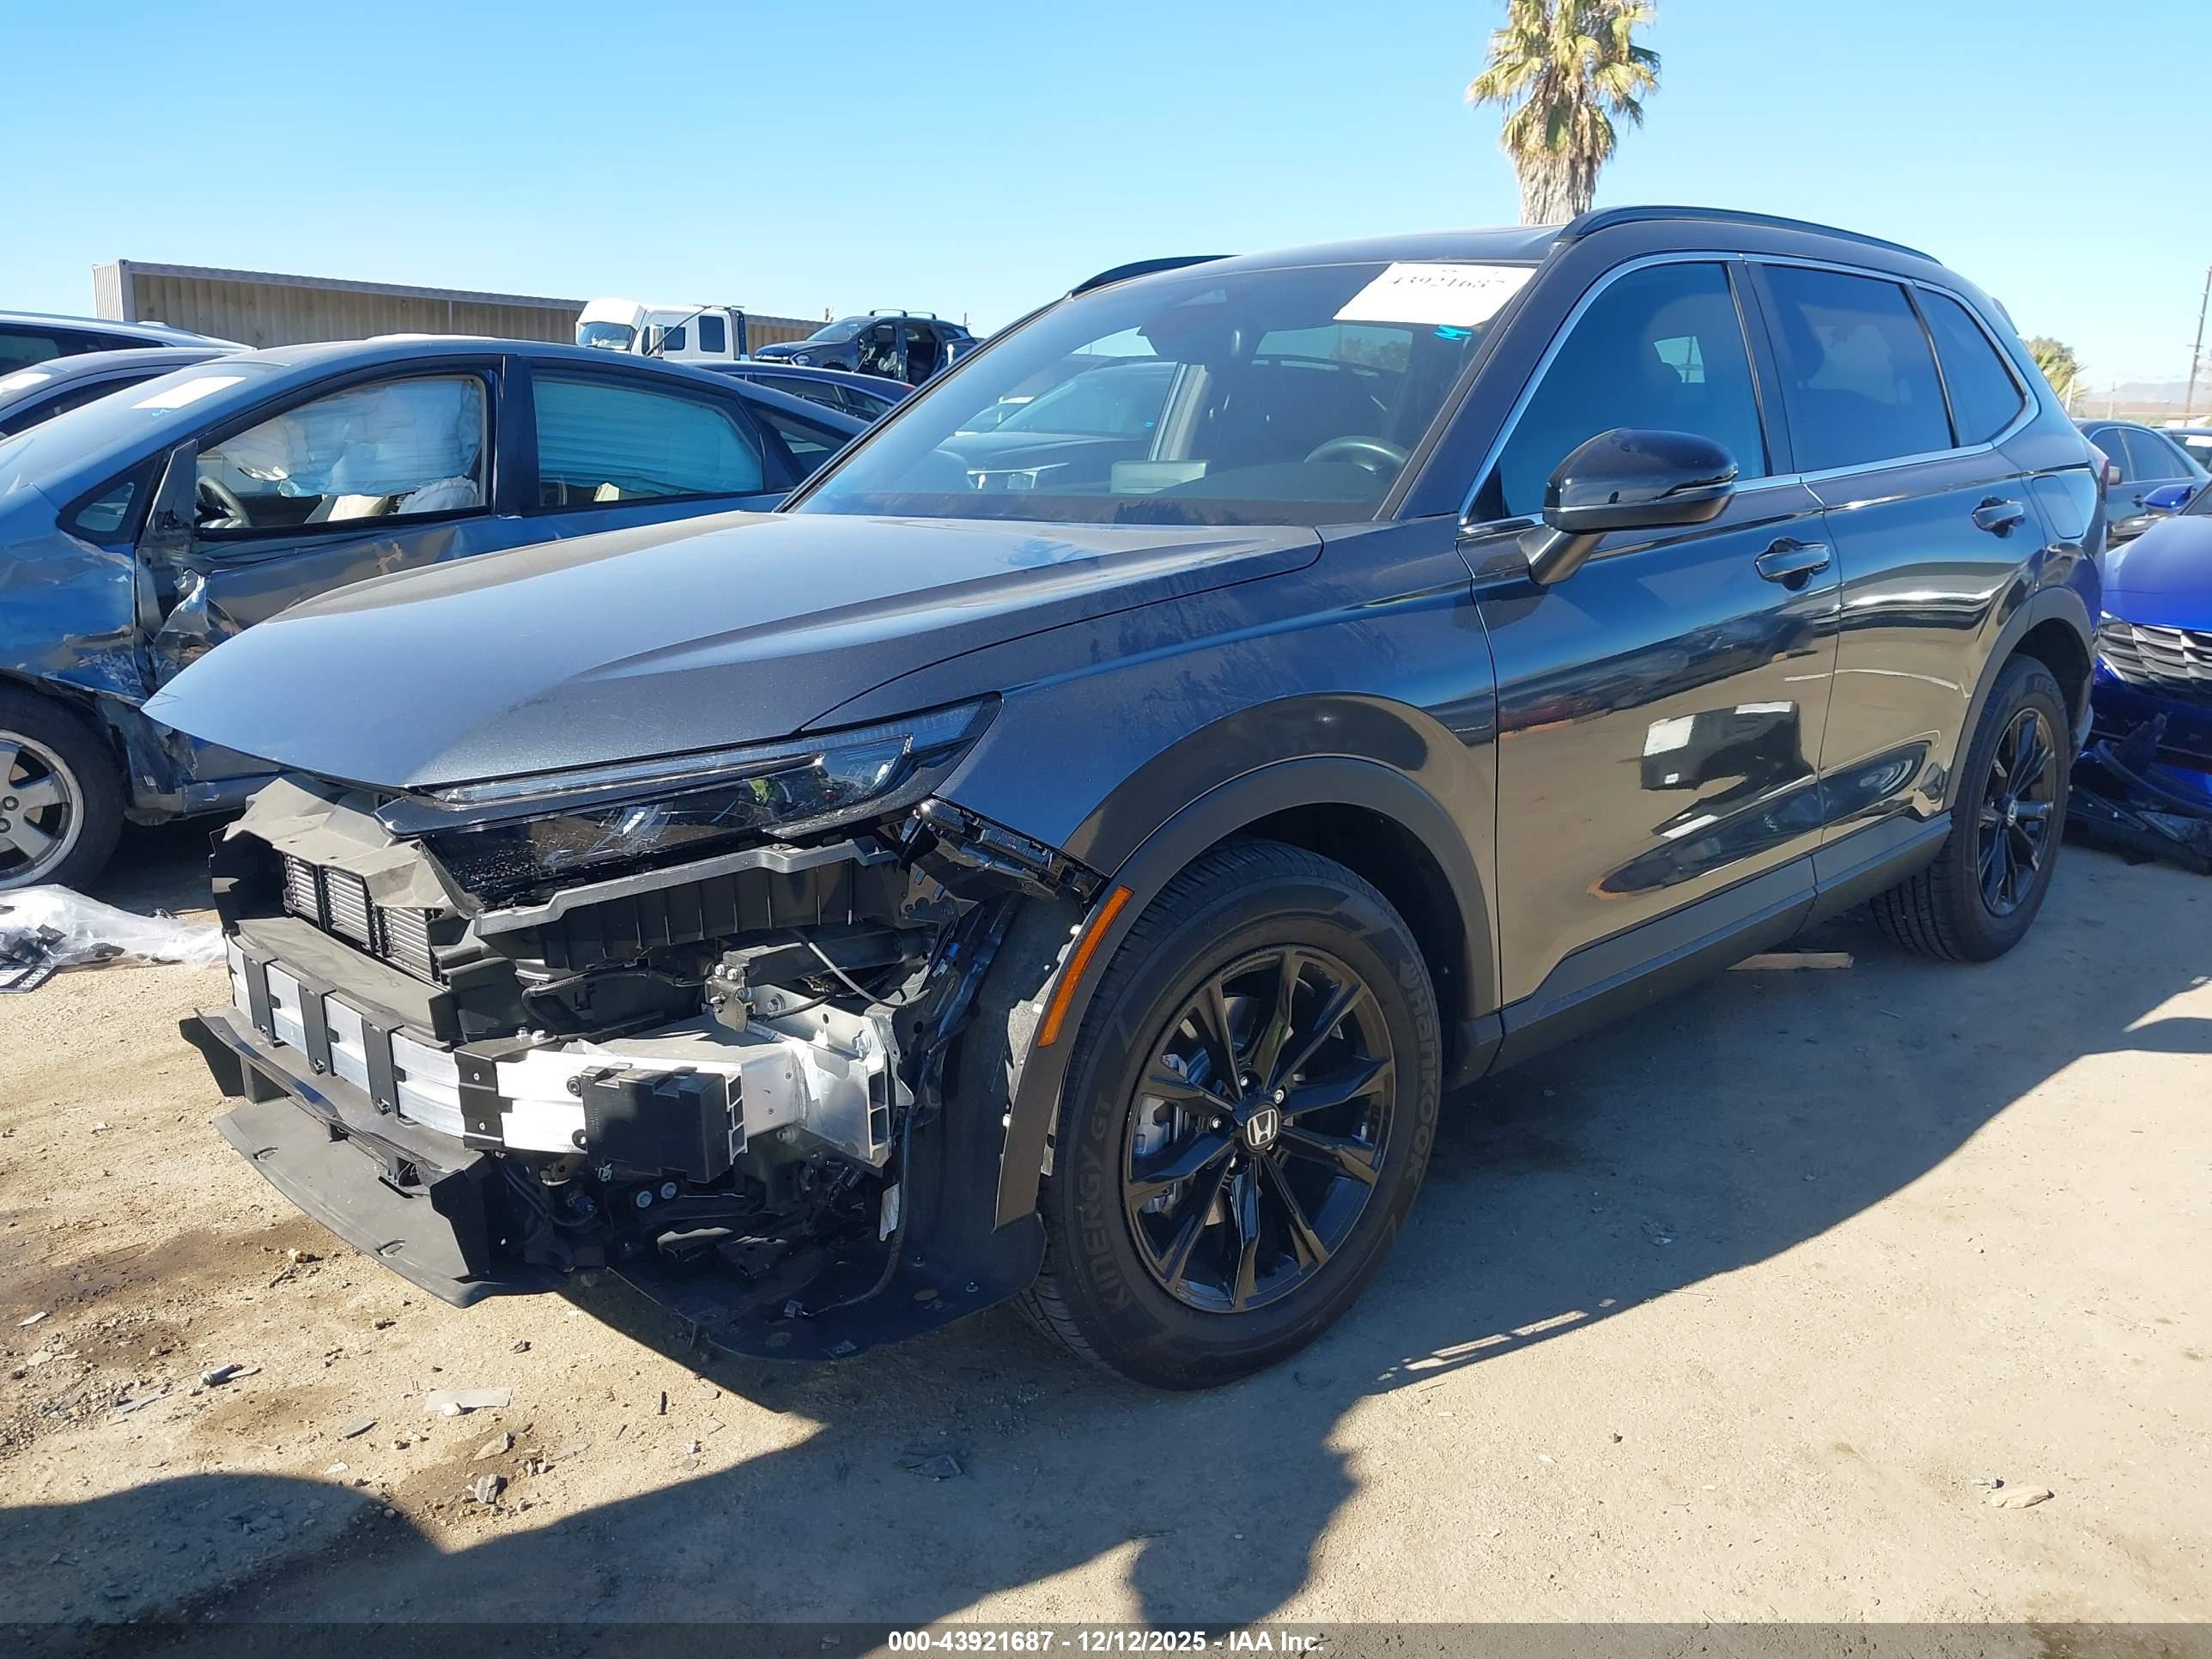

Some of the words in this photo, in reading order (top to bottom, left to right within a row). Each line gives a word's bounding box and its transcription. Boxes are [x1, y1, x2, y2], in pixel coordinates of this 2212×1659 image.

[1091, 1092, 1112, 1140] GT
[1405, 987, 1437, 1184] Hankook
[1079, 1143, 1133, 1312] KINERGY
